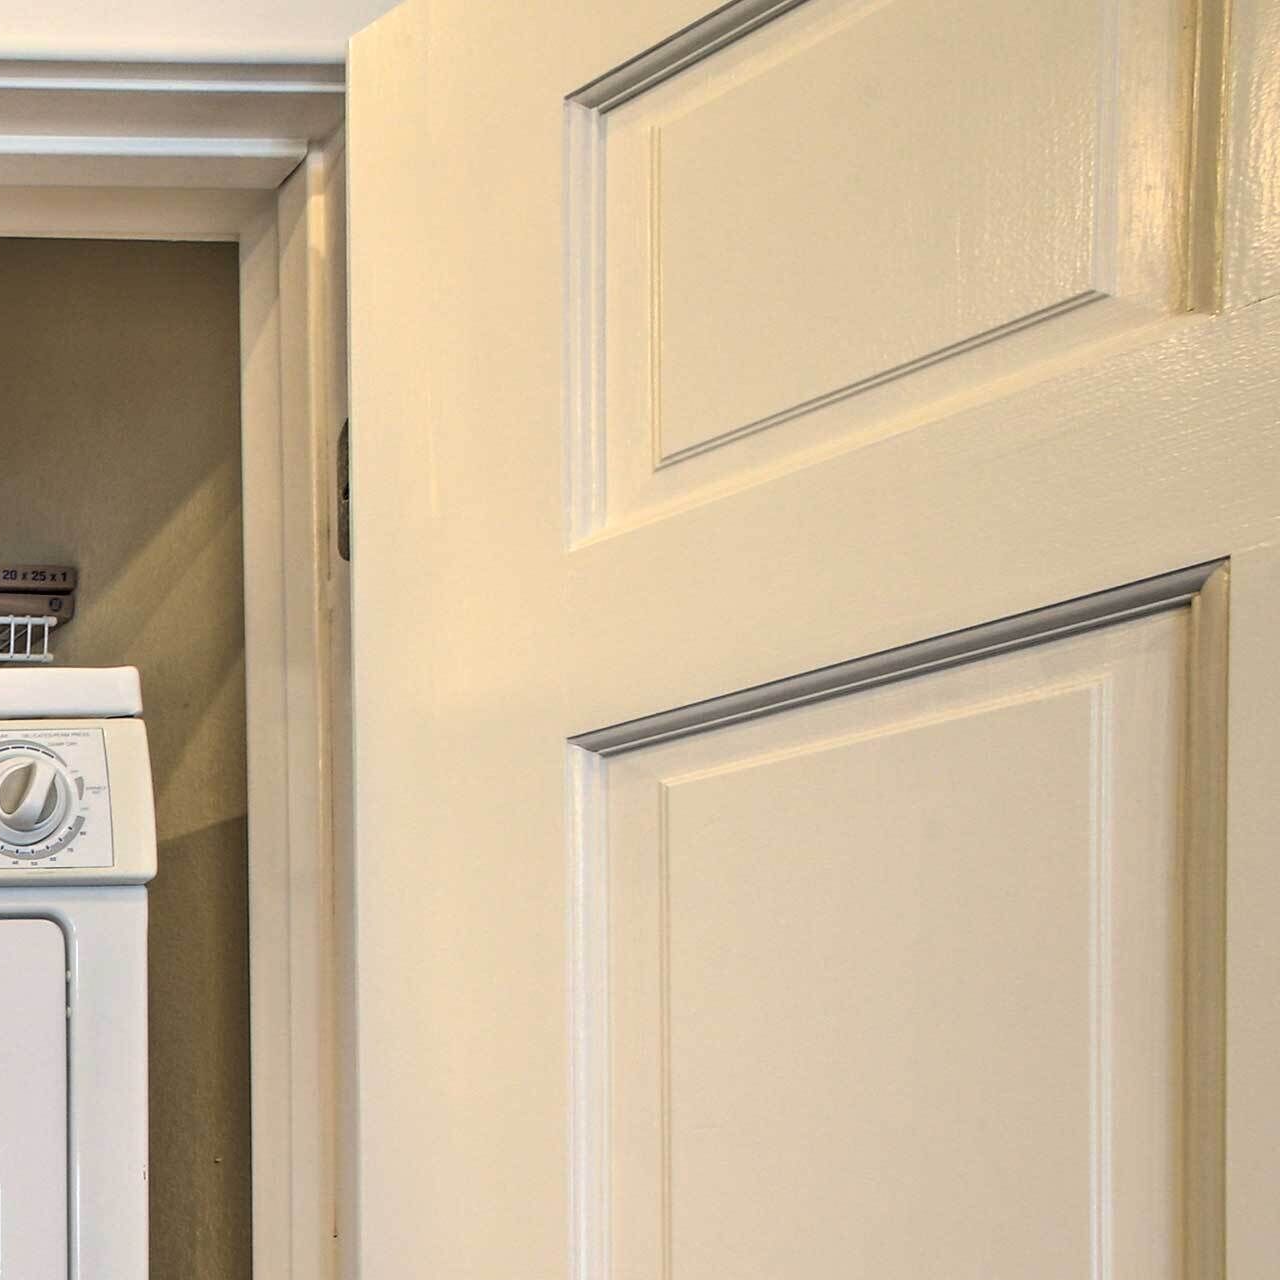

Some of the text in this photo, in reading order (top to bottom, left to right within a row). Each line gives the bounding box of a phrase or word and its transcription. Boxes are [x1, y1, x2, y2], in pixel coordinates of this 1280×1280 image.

[2, 569, 18, 581] 20
[32, 570, 47, 582] 25
[61, 571, 68, 582] 1
